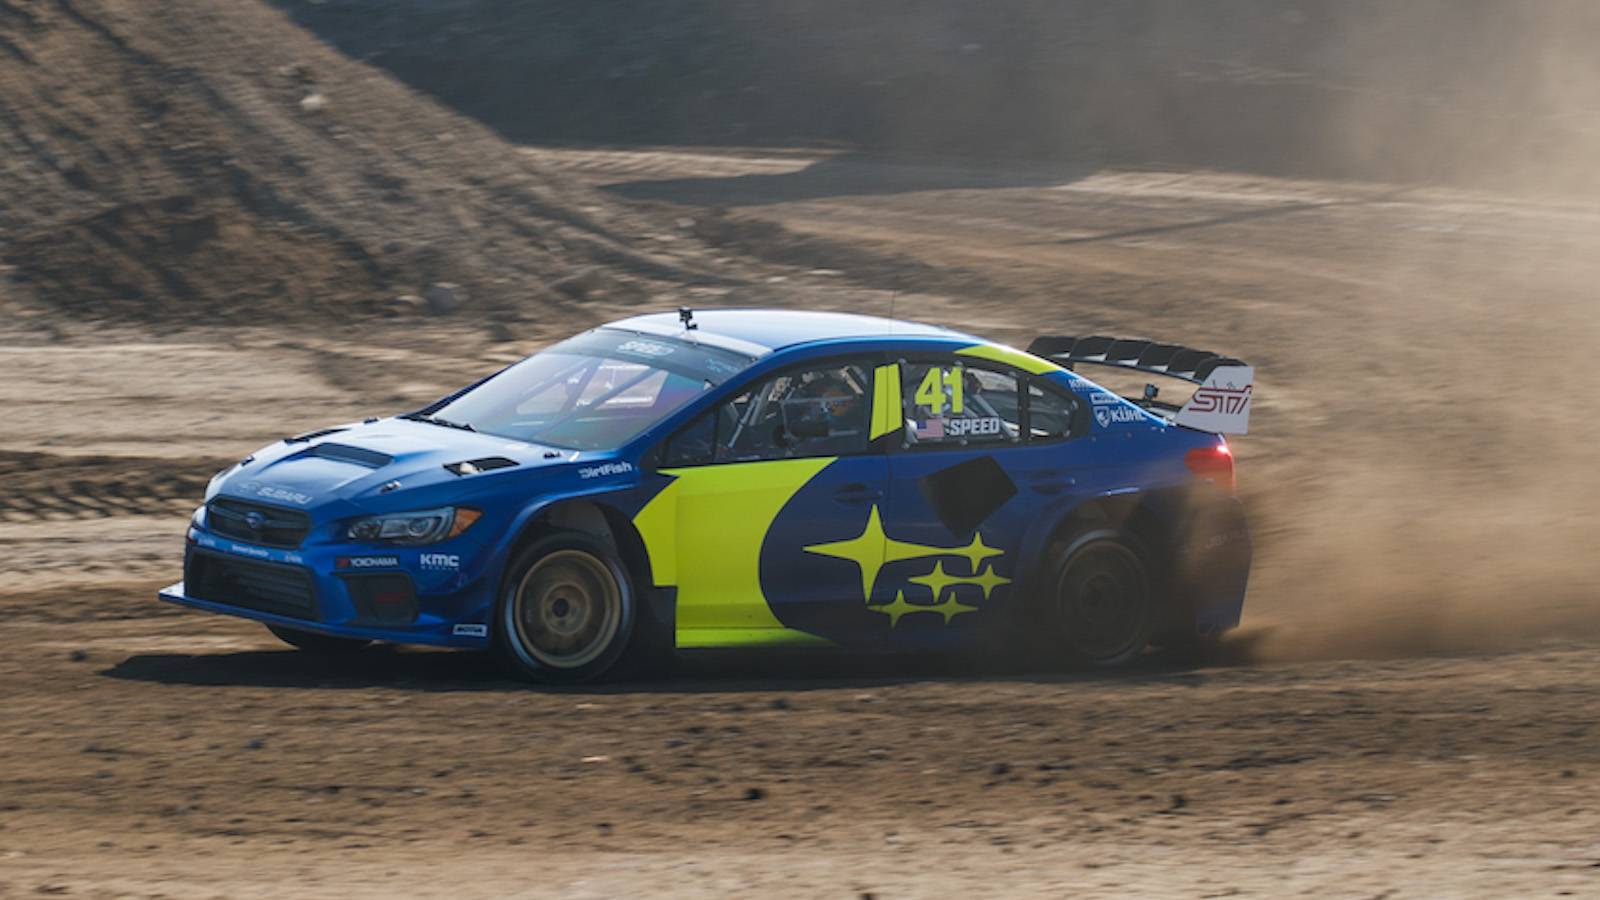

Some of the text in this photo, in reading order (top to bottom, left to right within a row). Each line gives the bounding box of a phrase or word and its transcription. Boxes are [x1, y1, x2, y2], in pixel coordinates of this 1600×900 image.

[915, 367, 964, 415] 41
[949, 418, 1000, 436] SPEED
[257, 487, 313, 505] SUBARU
[350, 557, 399, 568] YOKOHAMA
[420, 554, 460, 568] KMC
